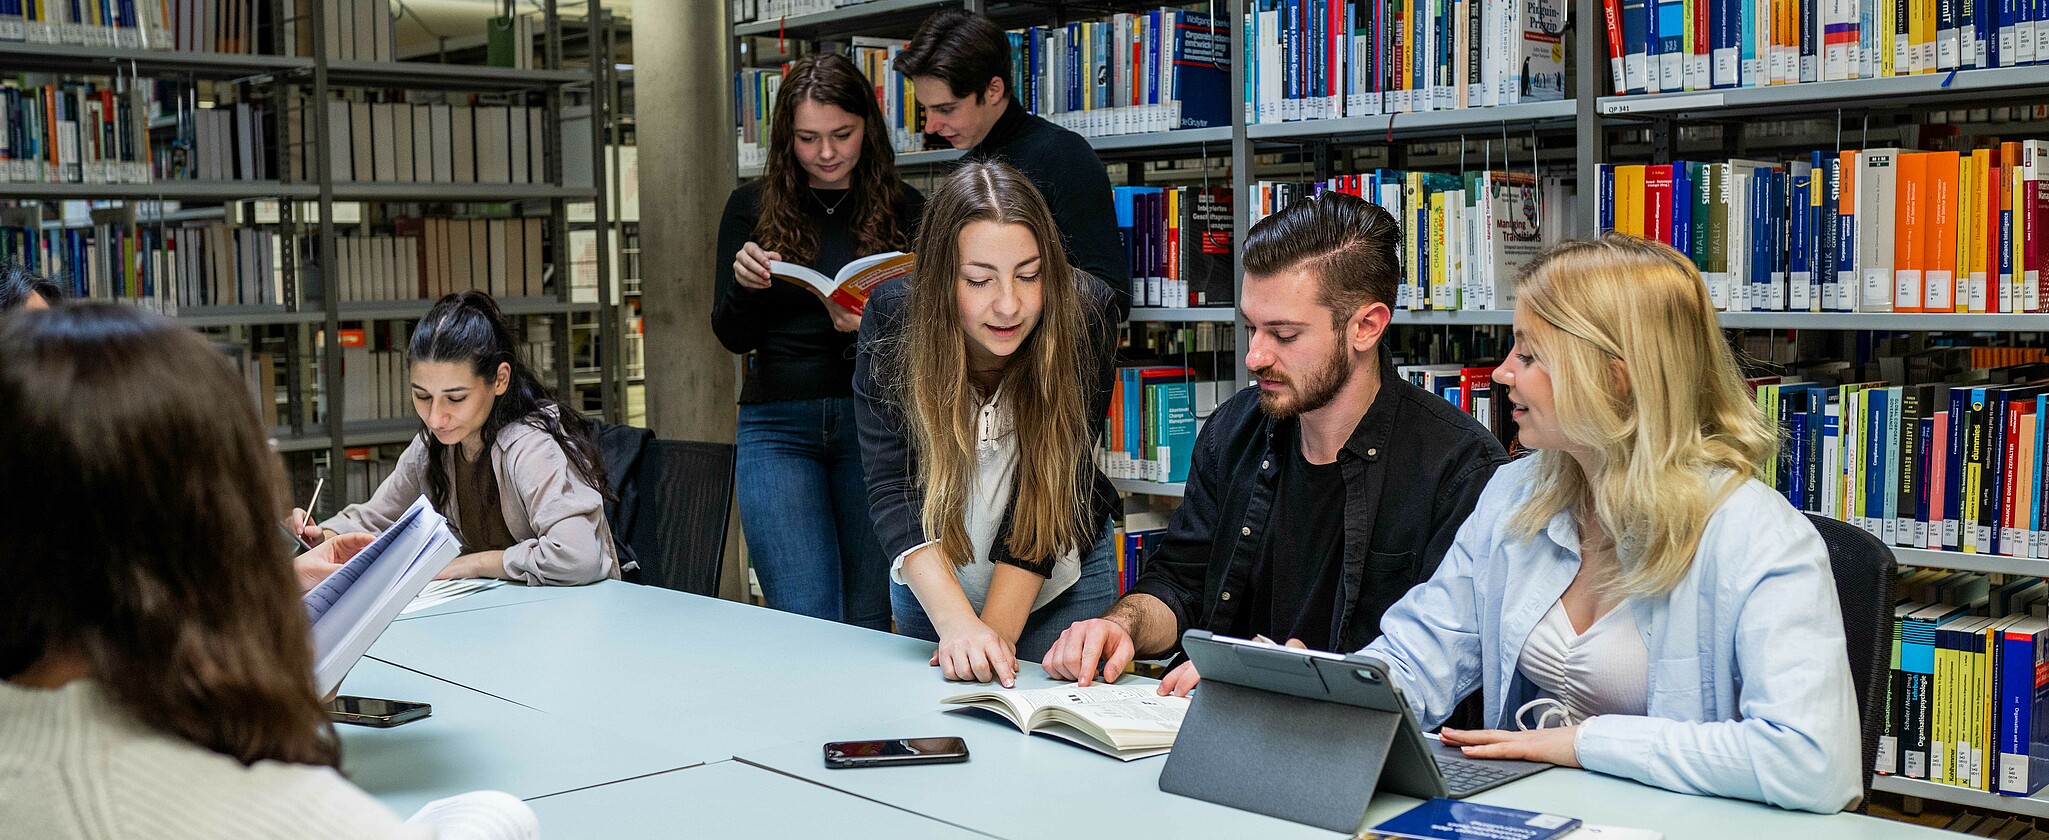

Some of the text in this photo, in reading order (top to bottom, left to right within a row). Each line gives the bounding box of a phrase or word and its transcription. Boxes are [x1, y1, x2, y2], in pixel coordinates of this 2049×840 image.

[1470, 2, 1478, 18] THE
[1606, 6, 1616, 30] DCGK
[1184, 40, 1226, 52] entwickung
[1395, 18, 1403, 46] CHANGE
[1414, 34, 1422, 77] Erfolgsfaktor
[1470, 50, 1478, 84] CATALYS
[1700, 164, 1710, 204] campus
[1719, 163, 1730, 204] campus
[1829, 158, 1840, 200] campus
[1438, 234, 1444, 246] AM
[1712, 222, 1720, 254] MALIK
[1824, 252, 1832, 283] MALIK
[1904, 423, 1913, 454] PLATFORM
[1972, 424, 1980, 461] dummies
[1808, 460, 1816, 492] Corporate
[1904, 456, 1912, 493] REVOLUTION
[1918, 675, 1928, 747] Organisationspsychologie
